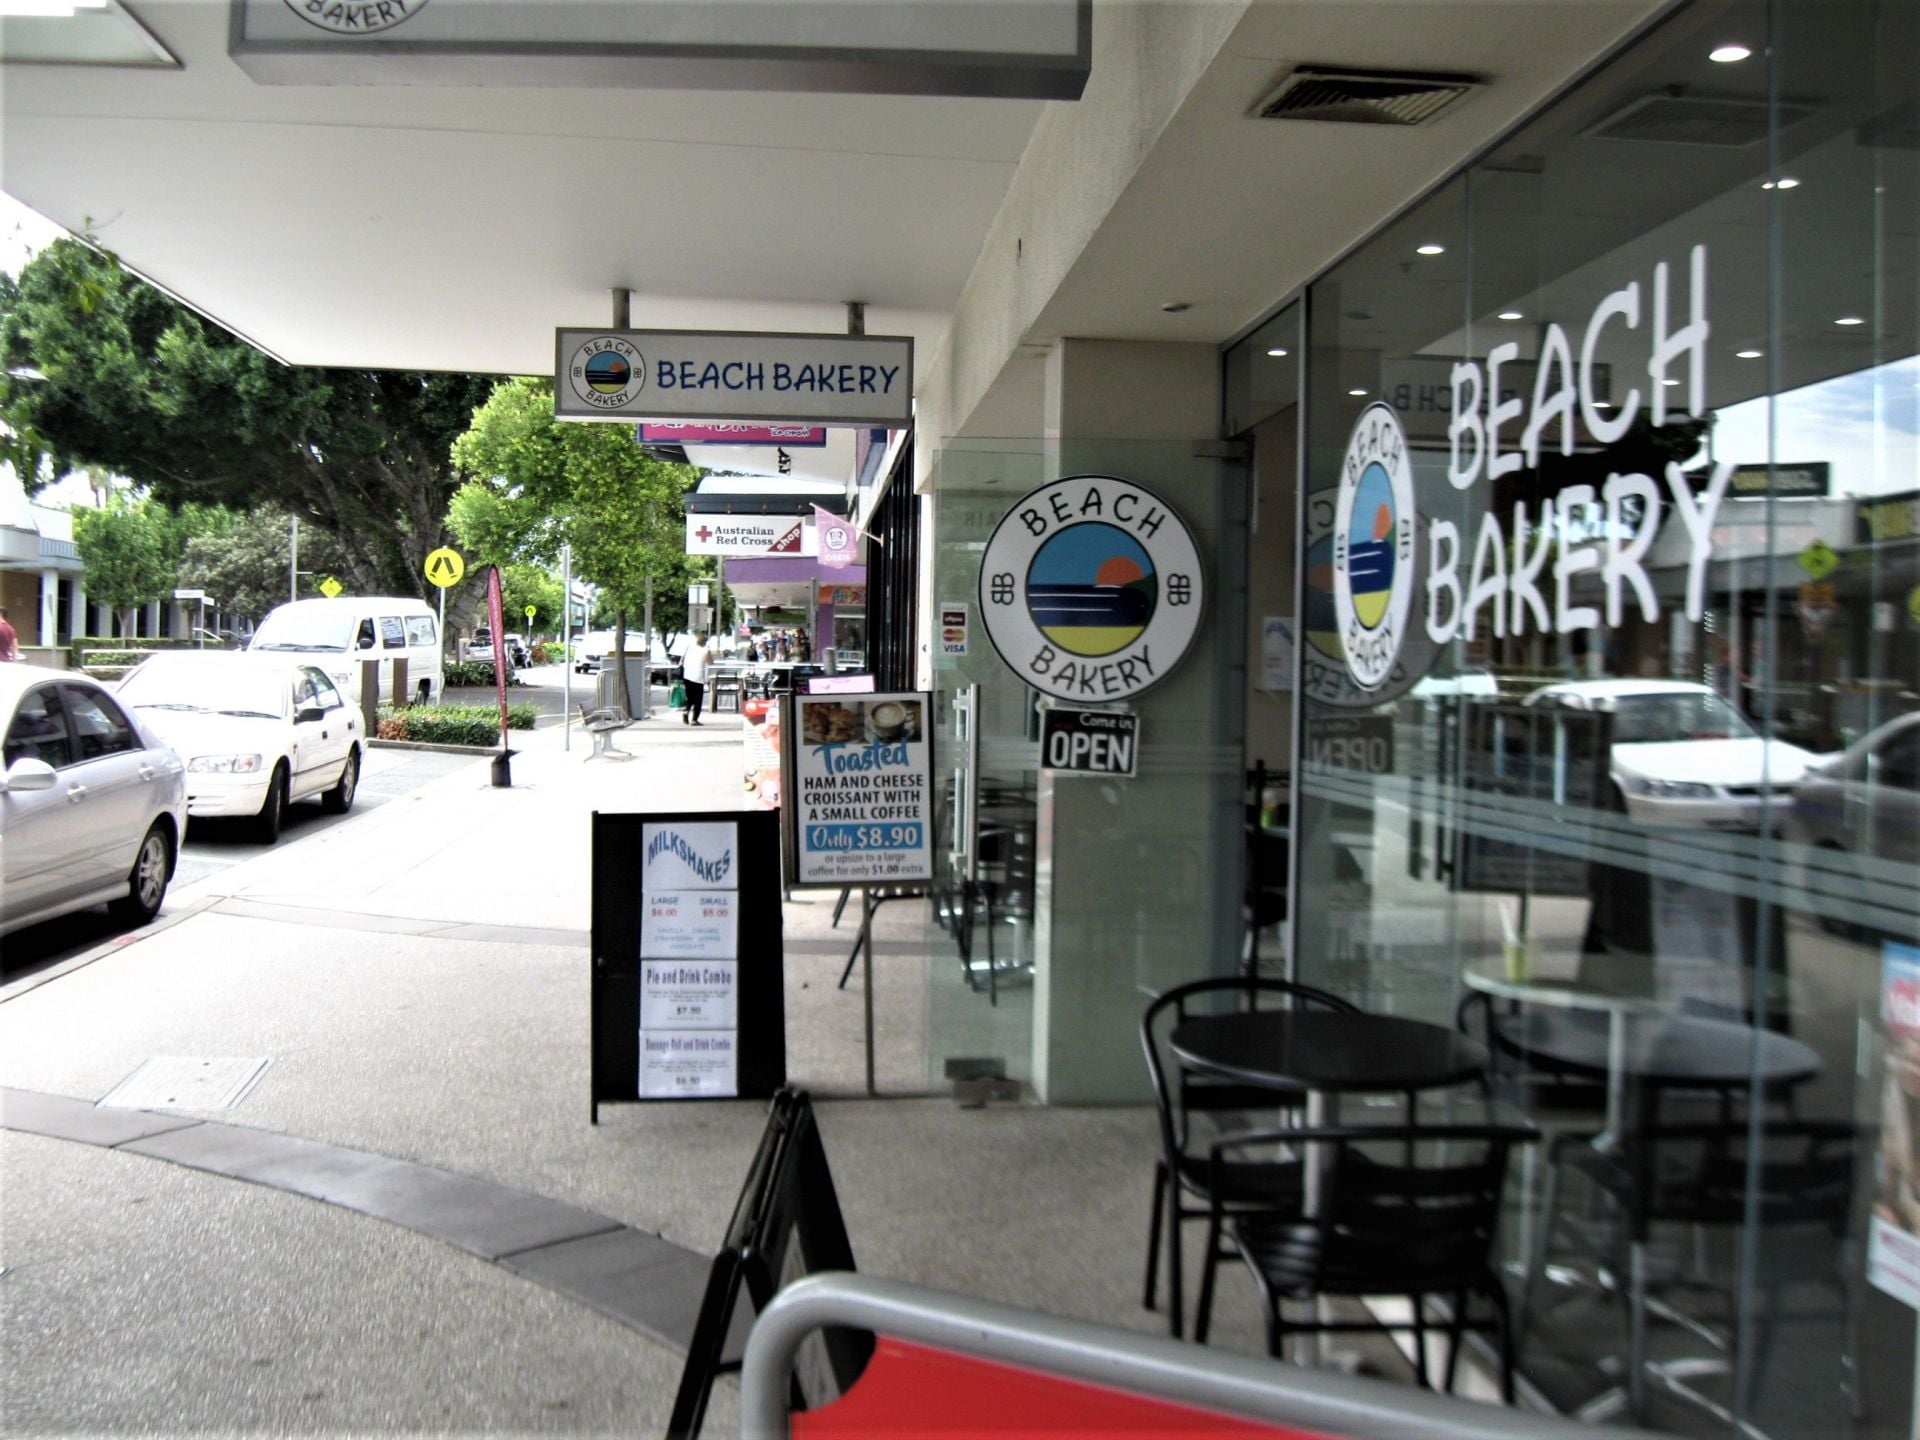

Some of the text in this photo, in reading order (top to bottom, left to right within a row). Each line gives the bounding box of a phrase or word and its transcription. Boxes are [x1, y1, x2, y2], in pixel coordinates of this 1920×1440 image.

[583, 340, 633, 356] BEACH
[1448, 245, 1709, 490] BEACH
[657, 360, 899, 394] BEACH BAKERY
[586, 390, 629, 406] BAKERY
[1347, 419, 1402, 487] BEACH
[1020, 487, 1166, 539] BEACH
[714, 526, 774, 536] Australian
[776, 527, 801, 551] shop
[716, 536, 774, 546] Red Cross
[1426, 460, 1736, 645] BAKERY
[944, 644, 965, 653] VISA
[1030, 644, 1155, 694] BAKERY
[1079, 712, 1116, 728] Come
[1119, 716, 1133, 730] in
[812, 737, 909, 776] Toasted
[1049, 730, 1131, 772] OPEN
[804, 774, 924, 790] HAM AND CHEESE
[804, 790, 920, 806] CROISSANT WITH
[809, 805, 920, 821] A SMALL COFFEE
[813, 826, 918, 853] Only $8.90
[648, 830, 730, 883] MILKSHAKES
[825, 855, 834, 863] or
[836, 853, 863, 865] upsize
[865, 853, 874, 862] to
[884, 852, 906, 863] large
[808, 864, 923, 877] coffee for only $1.00 extra
[651, 896, 680, 906] LARGE
[699, 896, 729, 906] SMALL
[646, 968, 732, 985] Pie and Drink Combo
